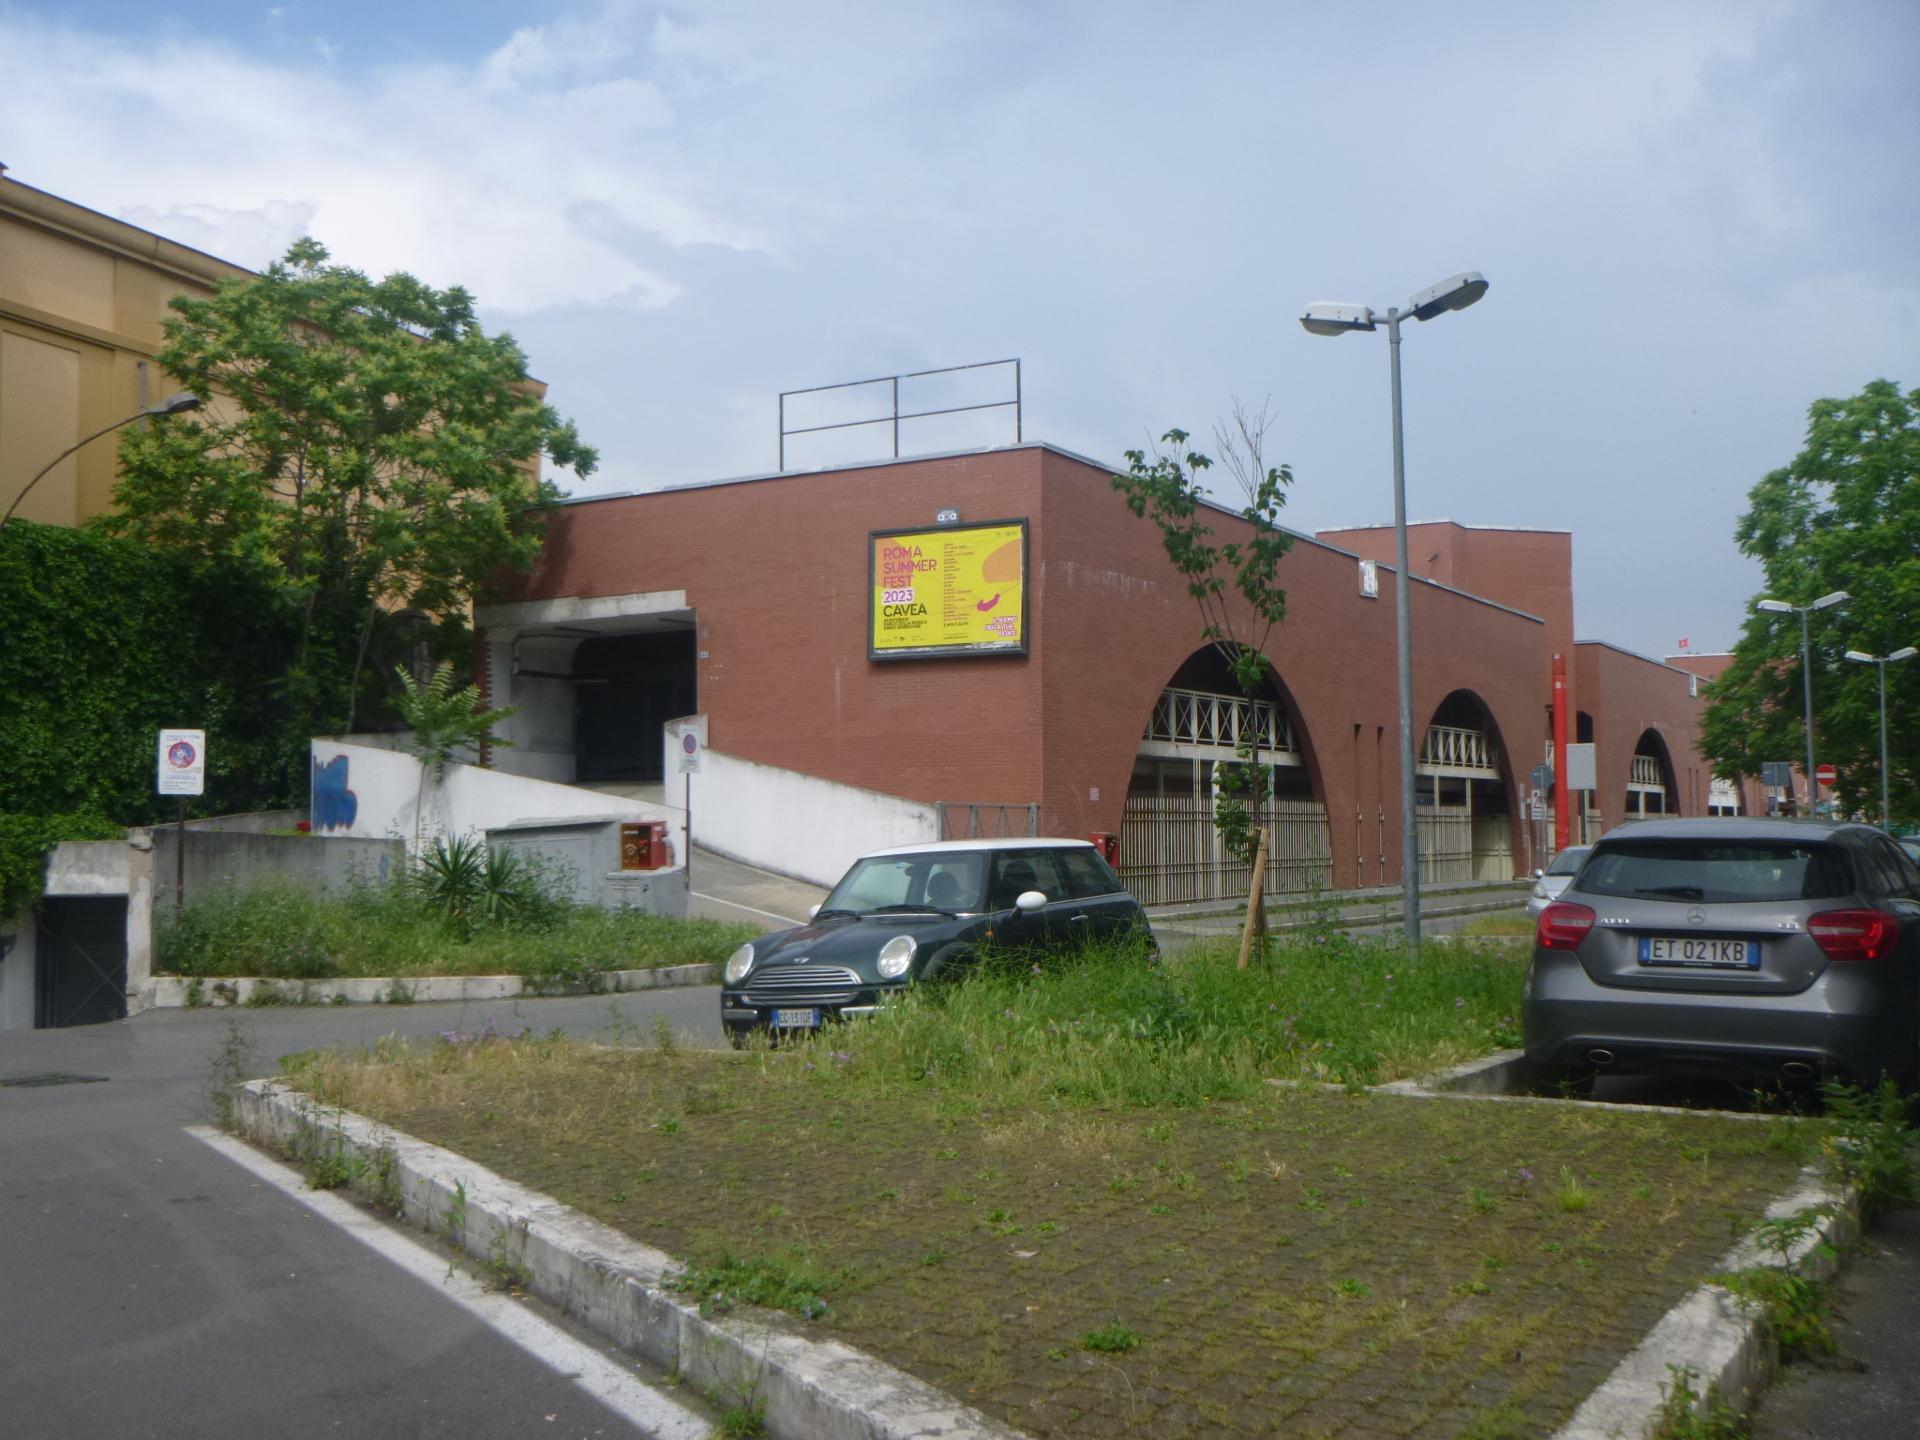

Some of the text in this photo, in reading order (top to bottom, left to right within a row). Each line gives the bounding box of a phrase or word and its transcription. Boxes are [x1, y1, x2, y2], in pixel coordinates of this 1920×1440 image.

[883, 545, 923, 560] ROMA
[883, 559, 938, 574] SUMMER
[883, 575, 914, 589] FEST
[883, 589, 914, 603] 2023
[883, 603, 928, 617] CAVEA
[1652, 939, 1744, 961] ET 021KB
